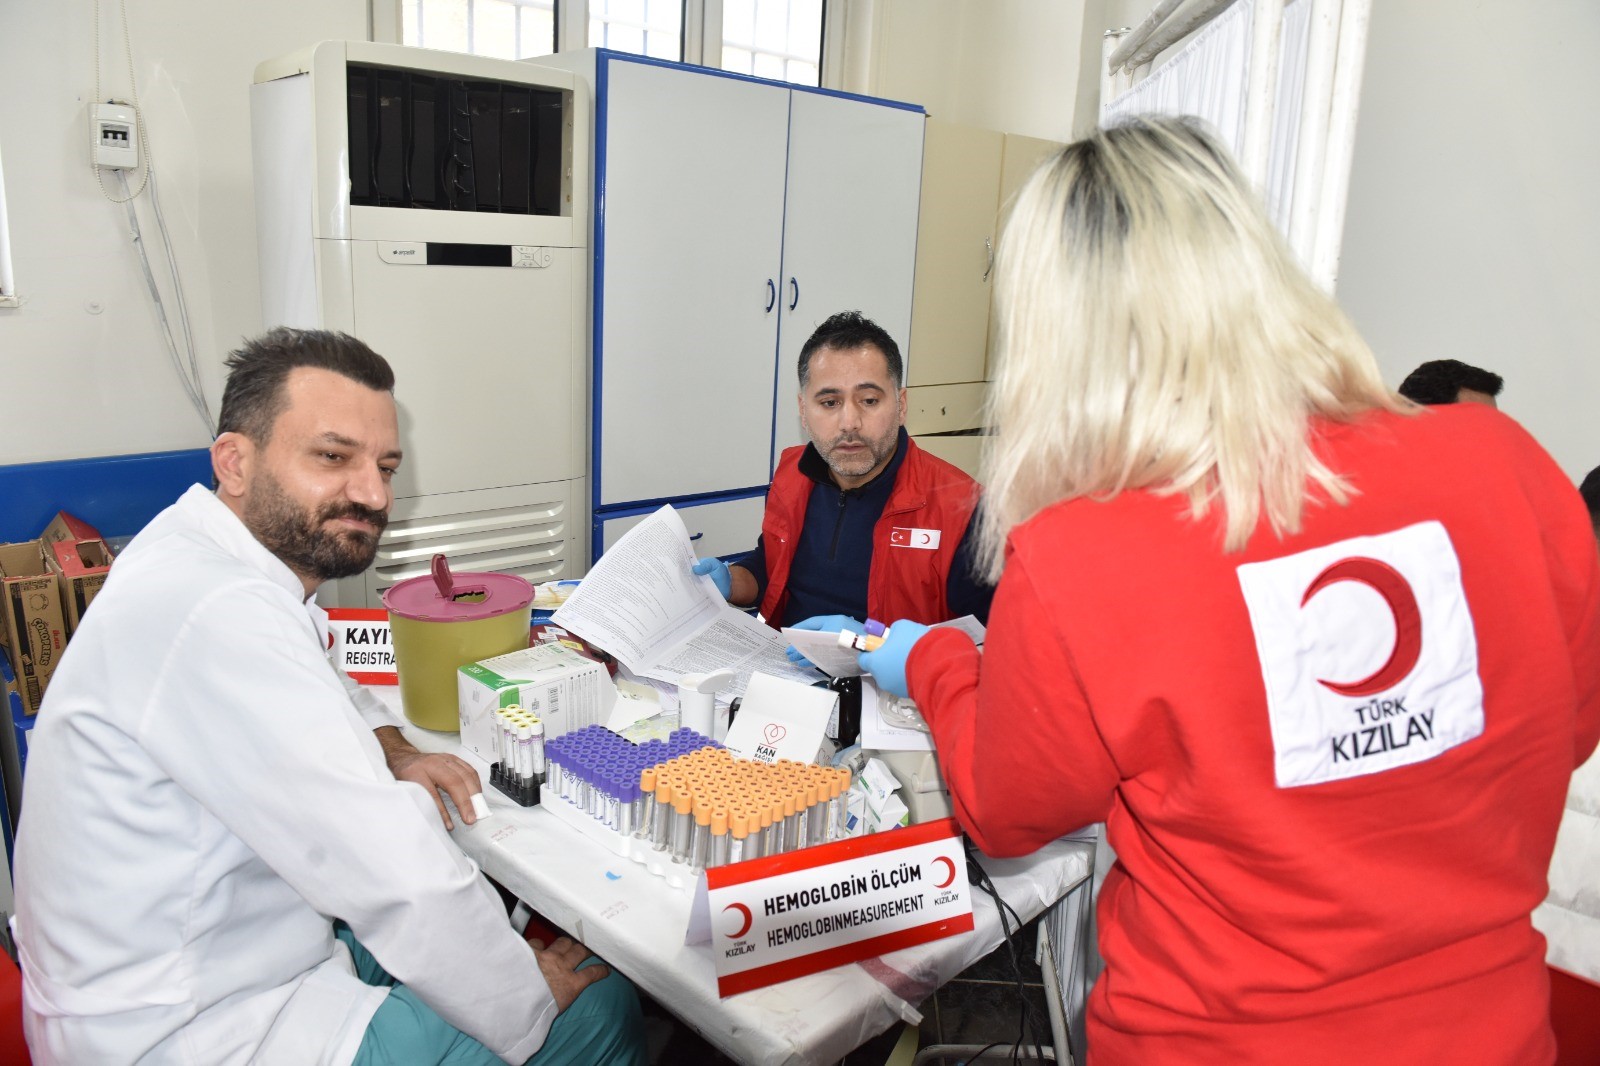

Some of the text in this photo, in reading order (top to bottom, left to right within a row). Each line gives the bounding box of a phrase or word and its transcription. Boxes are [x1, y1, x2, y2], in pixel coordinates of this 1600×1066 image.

[31, 618, 51, 666] ÇOKOPRENS
[346, 627, 393, 645] KAYI
[1355, 697, 1407, 725] TÜRK
[1332, 708, 1434, 763] KIZILAY
[756, 745, 776, 758] KAN
[764, 863, 922, 917] HEMOGLOBİN ÖLÇÜM
[934, 893, 960, 906] KIZILAY
[767, 894, 924, 948] HEMOGLOBINMEASUREMENT
[725, 944, 756, 959] KIZILAY
